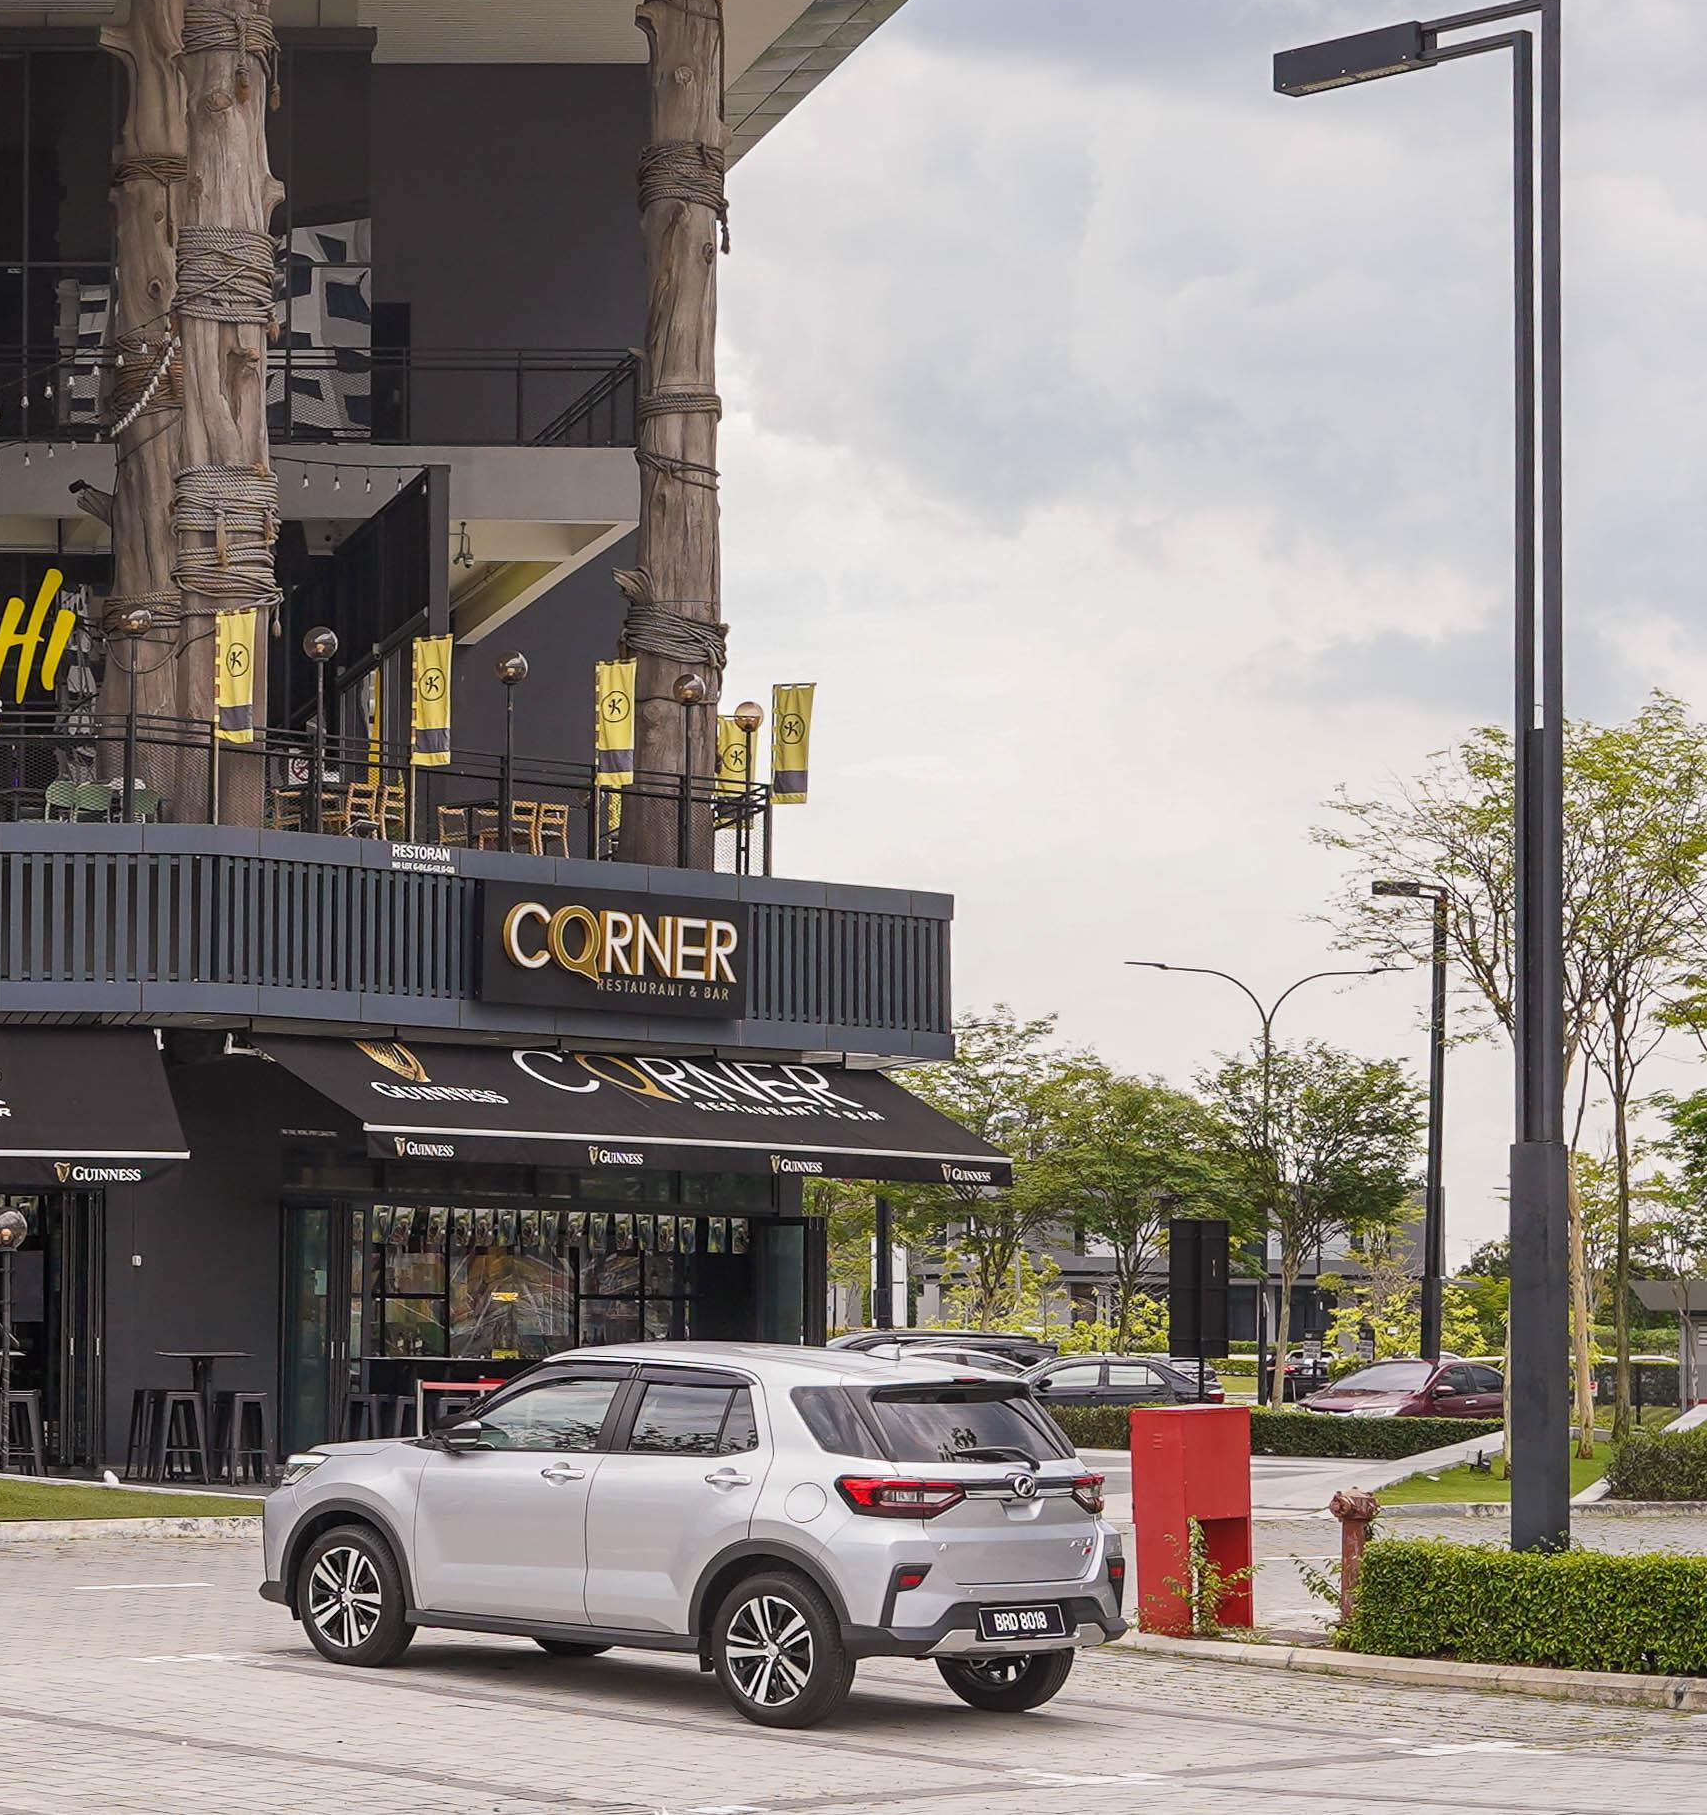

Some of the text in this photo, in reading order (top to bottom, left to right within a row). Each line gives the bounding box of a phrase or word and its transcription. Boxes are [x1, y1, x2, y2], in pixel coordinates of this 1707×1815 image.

[391, 843, 451, 862] RESTORAN
[503, 902, 738, 984] CORNER
[597, 979, 729, 1001] RESTAURANT & BAR
[512, 1050, 864, 1108] CORNER
[370, 1081, 510, 1105] GUINNESS
[693, 1100, 820, 1118] RESTAURANT
[842, 1110, 886, 1123] BAR
[406, 1141, 455, 1158] GUINNESS
[599, 1149, 644, 1165] GUINNESS
[72, 1165, 142, 1182] GUINNESS
[780, 1158, 823, 1174] GUINNESS
[951, 1167, 992, 1183] GUINNESS
[993, 1610, 1048, 1632] BRD 8018
